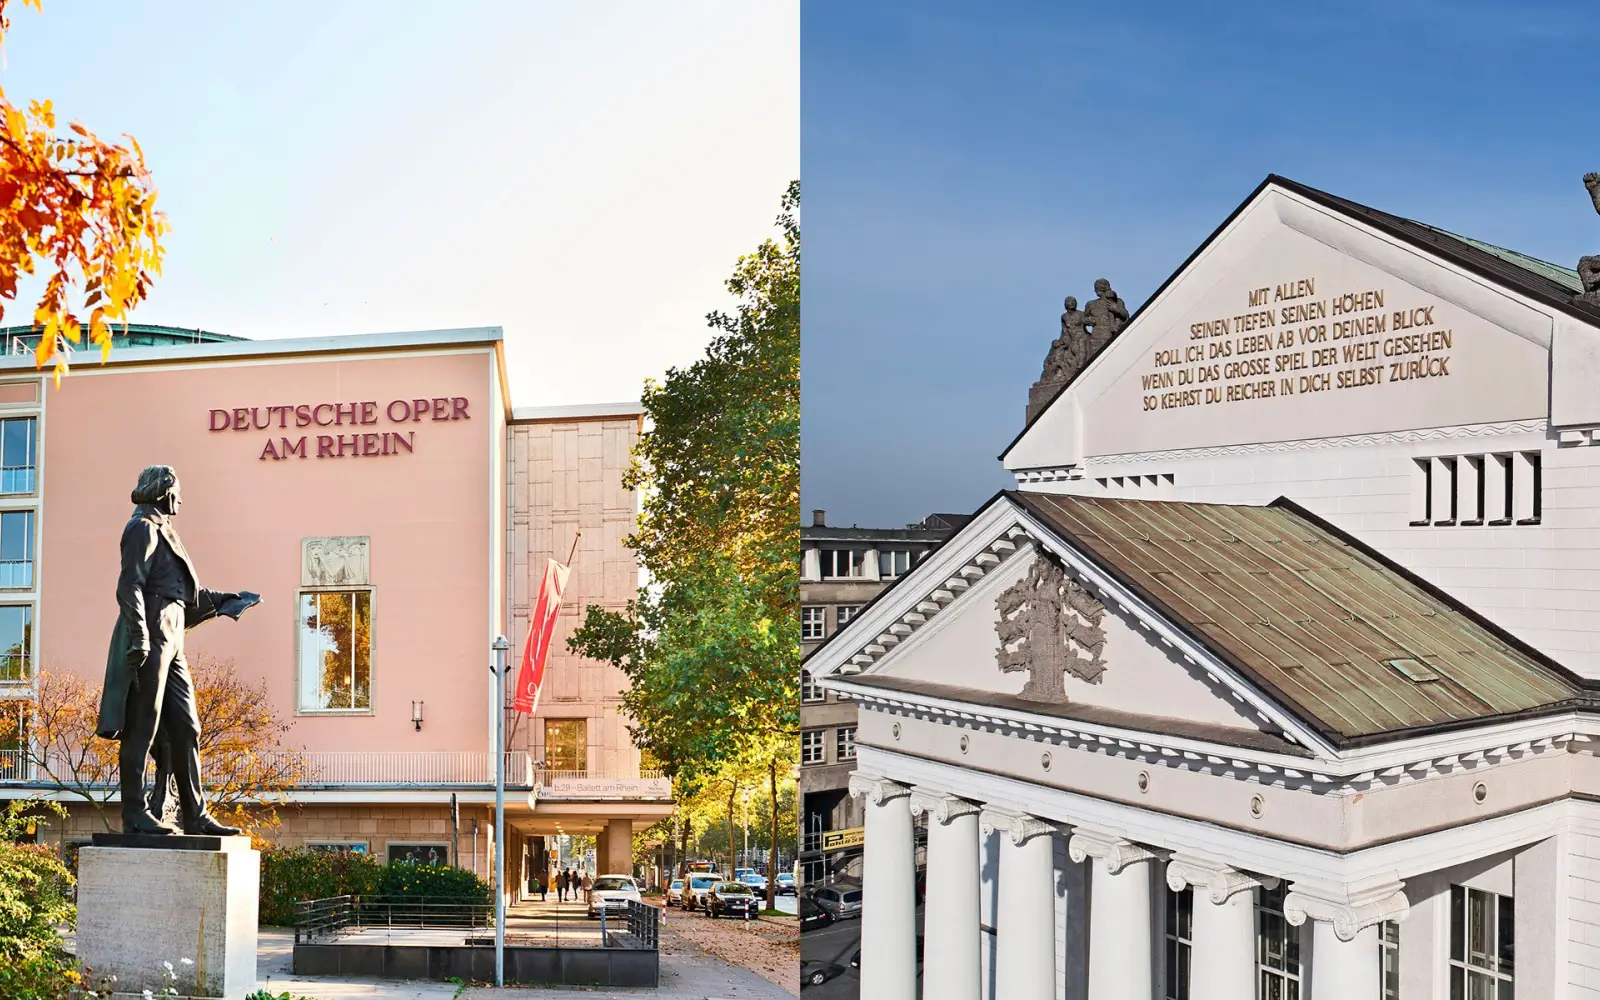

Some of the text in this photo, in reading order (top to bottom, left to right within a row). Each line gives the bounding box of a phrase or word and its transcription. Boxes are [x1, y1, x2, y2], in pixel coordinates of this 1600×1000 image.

[1248, 278, 1315, 307] MIT ALLEN
[1190, 289, 1384, 340] SEINEN TIEFEN SEINEN HÖHEN
[1155, 305, 1434, 367] ROLL ICH DAS LEBEN AB VOR DEINEM BLICK
[1142, 329, 1452, 390] WENN DU DAS GROSSE SPIEL DER WELT GESEHEN
[1143, 355, 1450, 412] SO KEHRST DU REICHER IN DICH SELBST ZURÜCK
[208, 397, 471, 431] DEUTSCHE OPER
[259, 431, 415, 460] AM RHEIN
[576, 784, 602, 792] Ballett
[616, 784, 638, 792] Rhein
